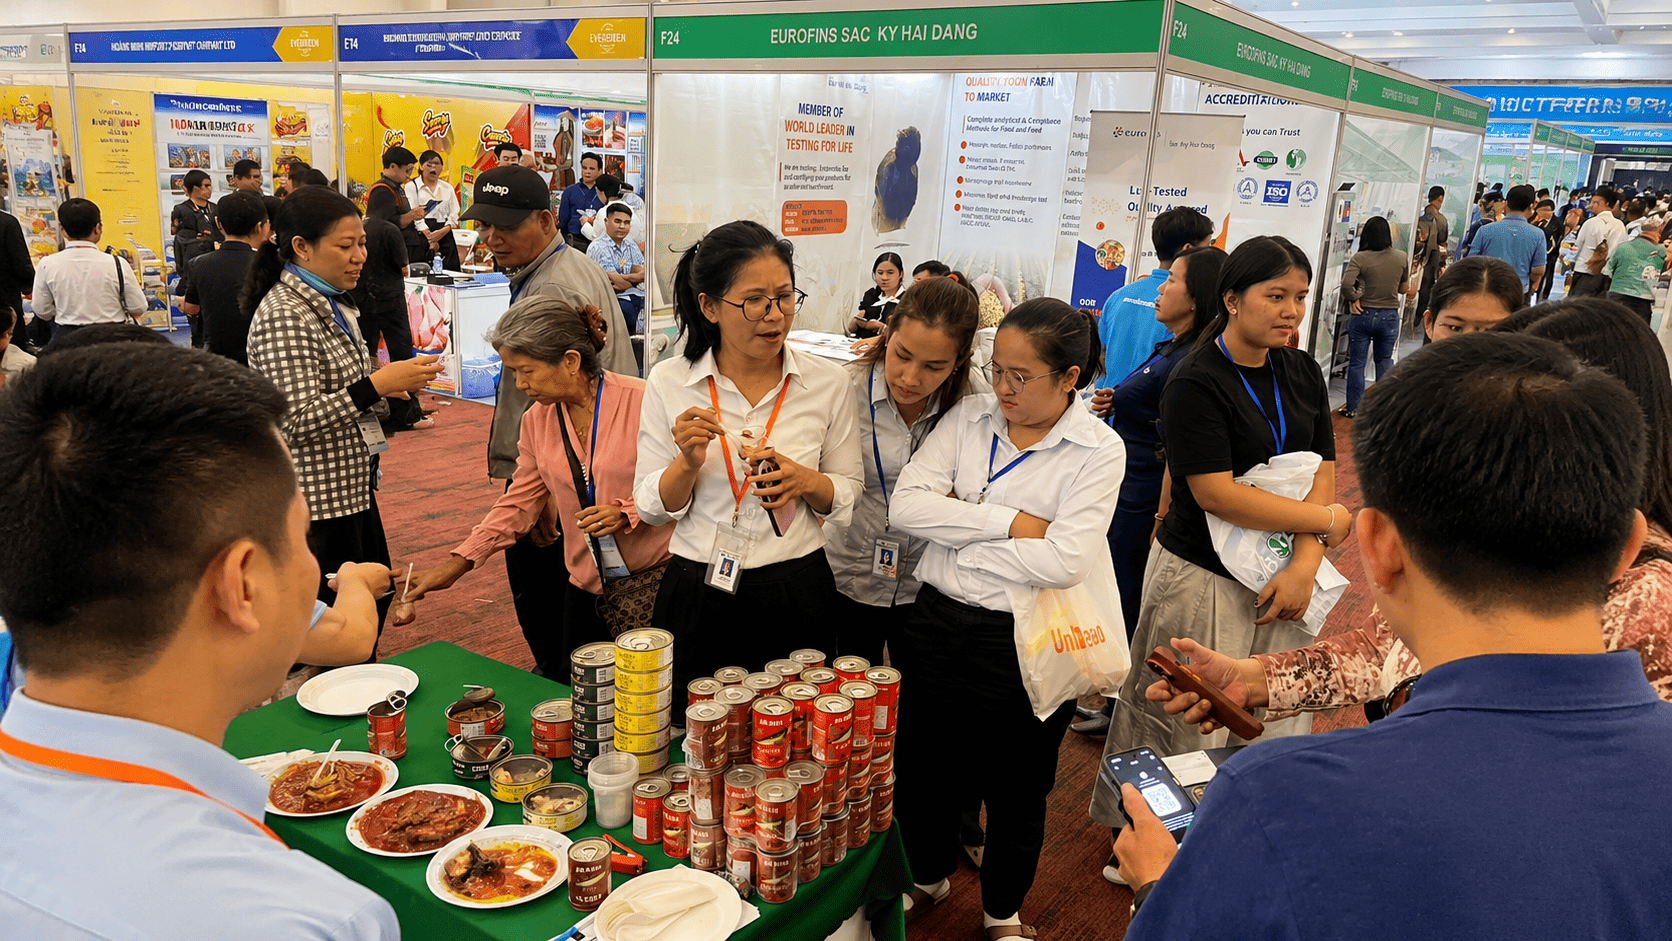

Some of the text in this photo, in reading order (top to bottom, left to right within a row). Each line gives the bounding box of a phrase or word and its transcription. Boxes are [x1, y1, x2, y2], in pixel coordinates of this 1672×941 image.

[770, 22, 978, 44] EUROFINS SAC KY HAI DANG
[1173, 20, 1188, 40] F24
[660, 31, 680, 45] F24
[965, 92, 1011, 102] TO MARKET
[798, 102, 844, 118] MEMBER OF
[784, 119, 855, 136] WORLD LEADER IN
[1245, 128, 1261, 137] you
[1279, 128, 1301, 137] Trust
[786, 138, 854, 153] TESTING FOR LIFE
[1266, 186, 1288, 196] ISO
